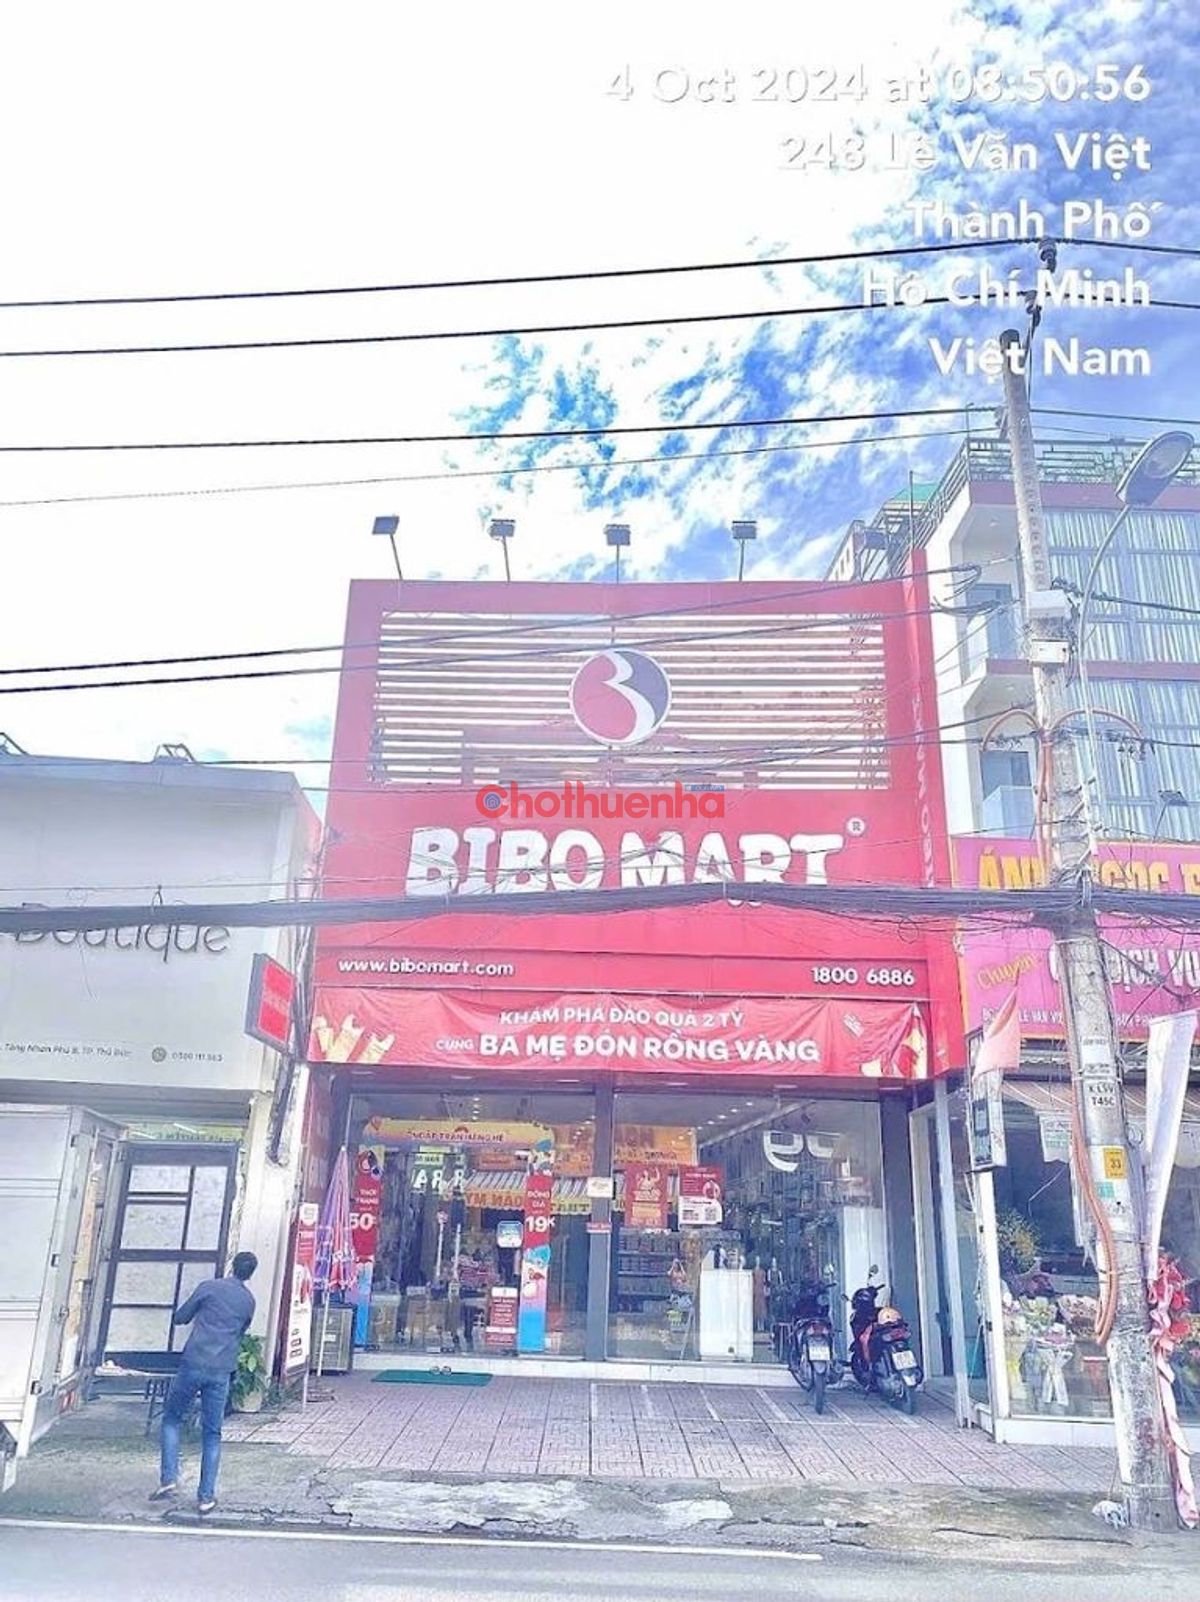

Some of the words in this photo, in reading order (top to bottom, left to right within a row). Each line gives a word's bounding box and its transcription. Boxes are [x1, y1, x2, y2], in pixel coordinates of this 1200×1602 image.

[405, 827, 606, 896] BIBO
[620, 831, 844, 888] MART
[338, 957, 514, 976] www.bibomart.com
[811, 966, 858, 985] 1800
[866, 968, 915, 986] 6886
[702, 1013, 715, 1027] 2
[480, 1034, 519, 1056] BA
[526, 1034, 567, 1062] MẸ
[574, 1030, 637, 1058] ĐÓN
[735, 1034, 820, 1062] VÀNG
